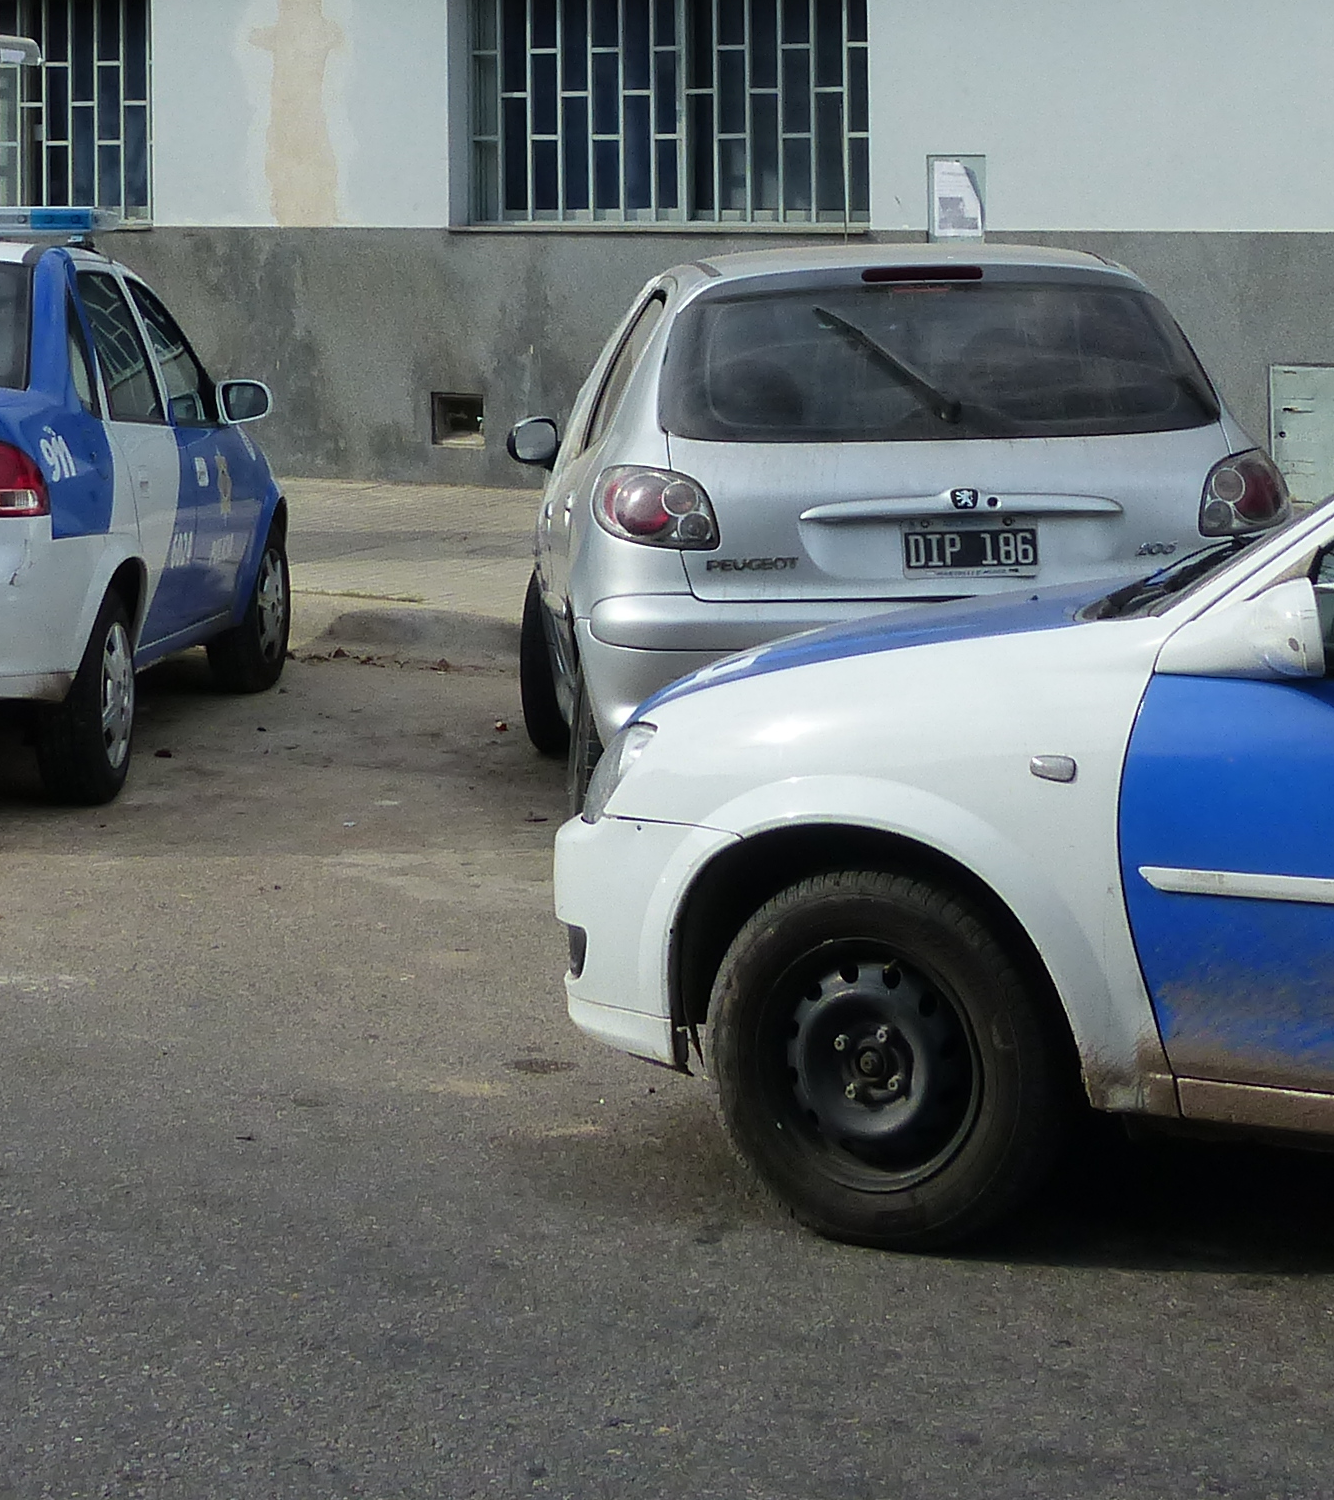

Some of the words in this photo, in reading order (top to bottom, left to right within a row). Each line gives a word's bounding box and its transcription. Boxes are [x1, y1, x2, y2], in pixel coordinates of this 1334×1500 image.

[40, 435, 77, 483] 911
[706, 557, 799, 572] PEUGEOT
[908, 533, 961, 567] DIP
[980, 532, 1035, 566] 186
